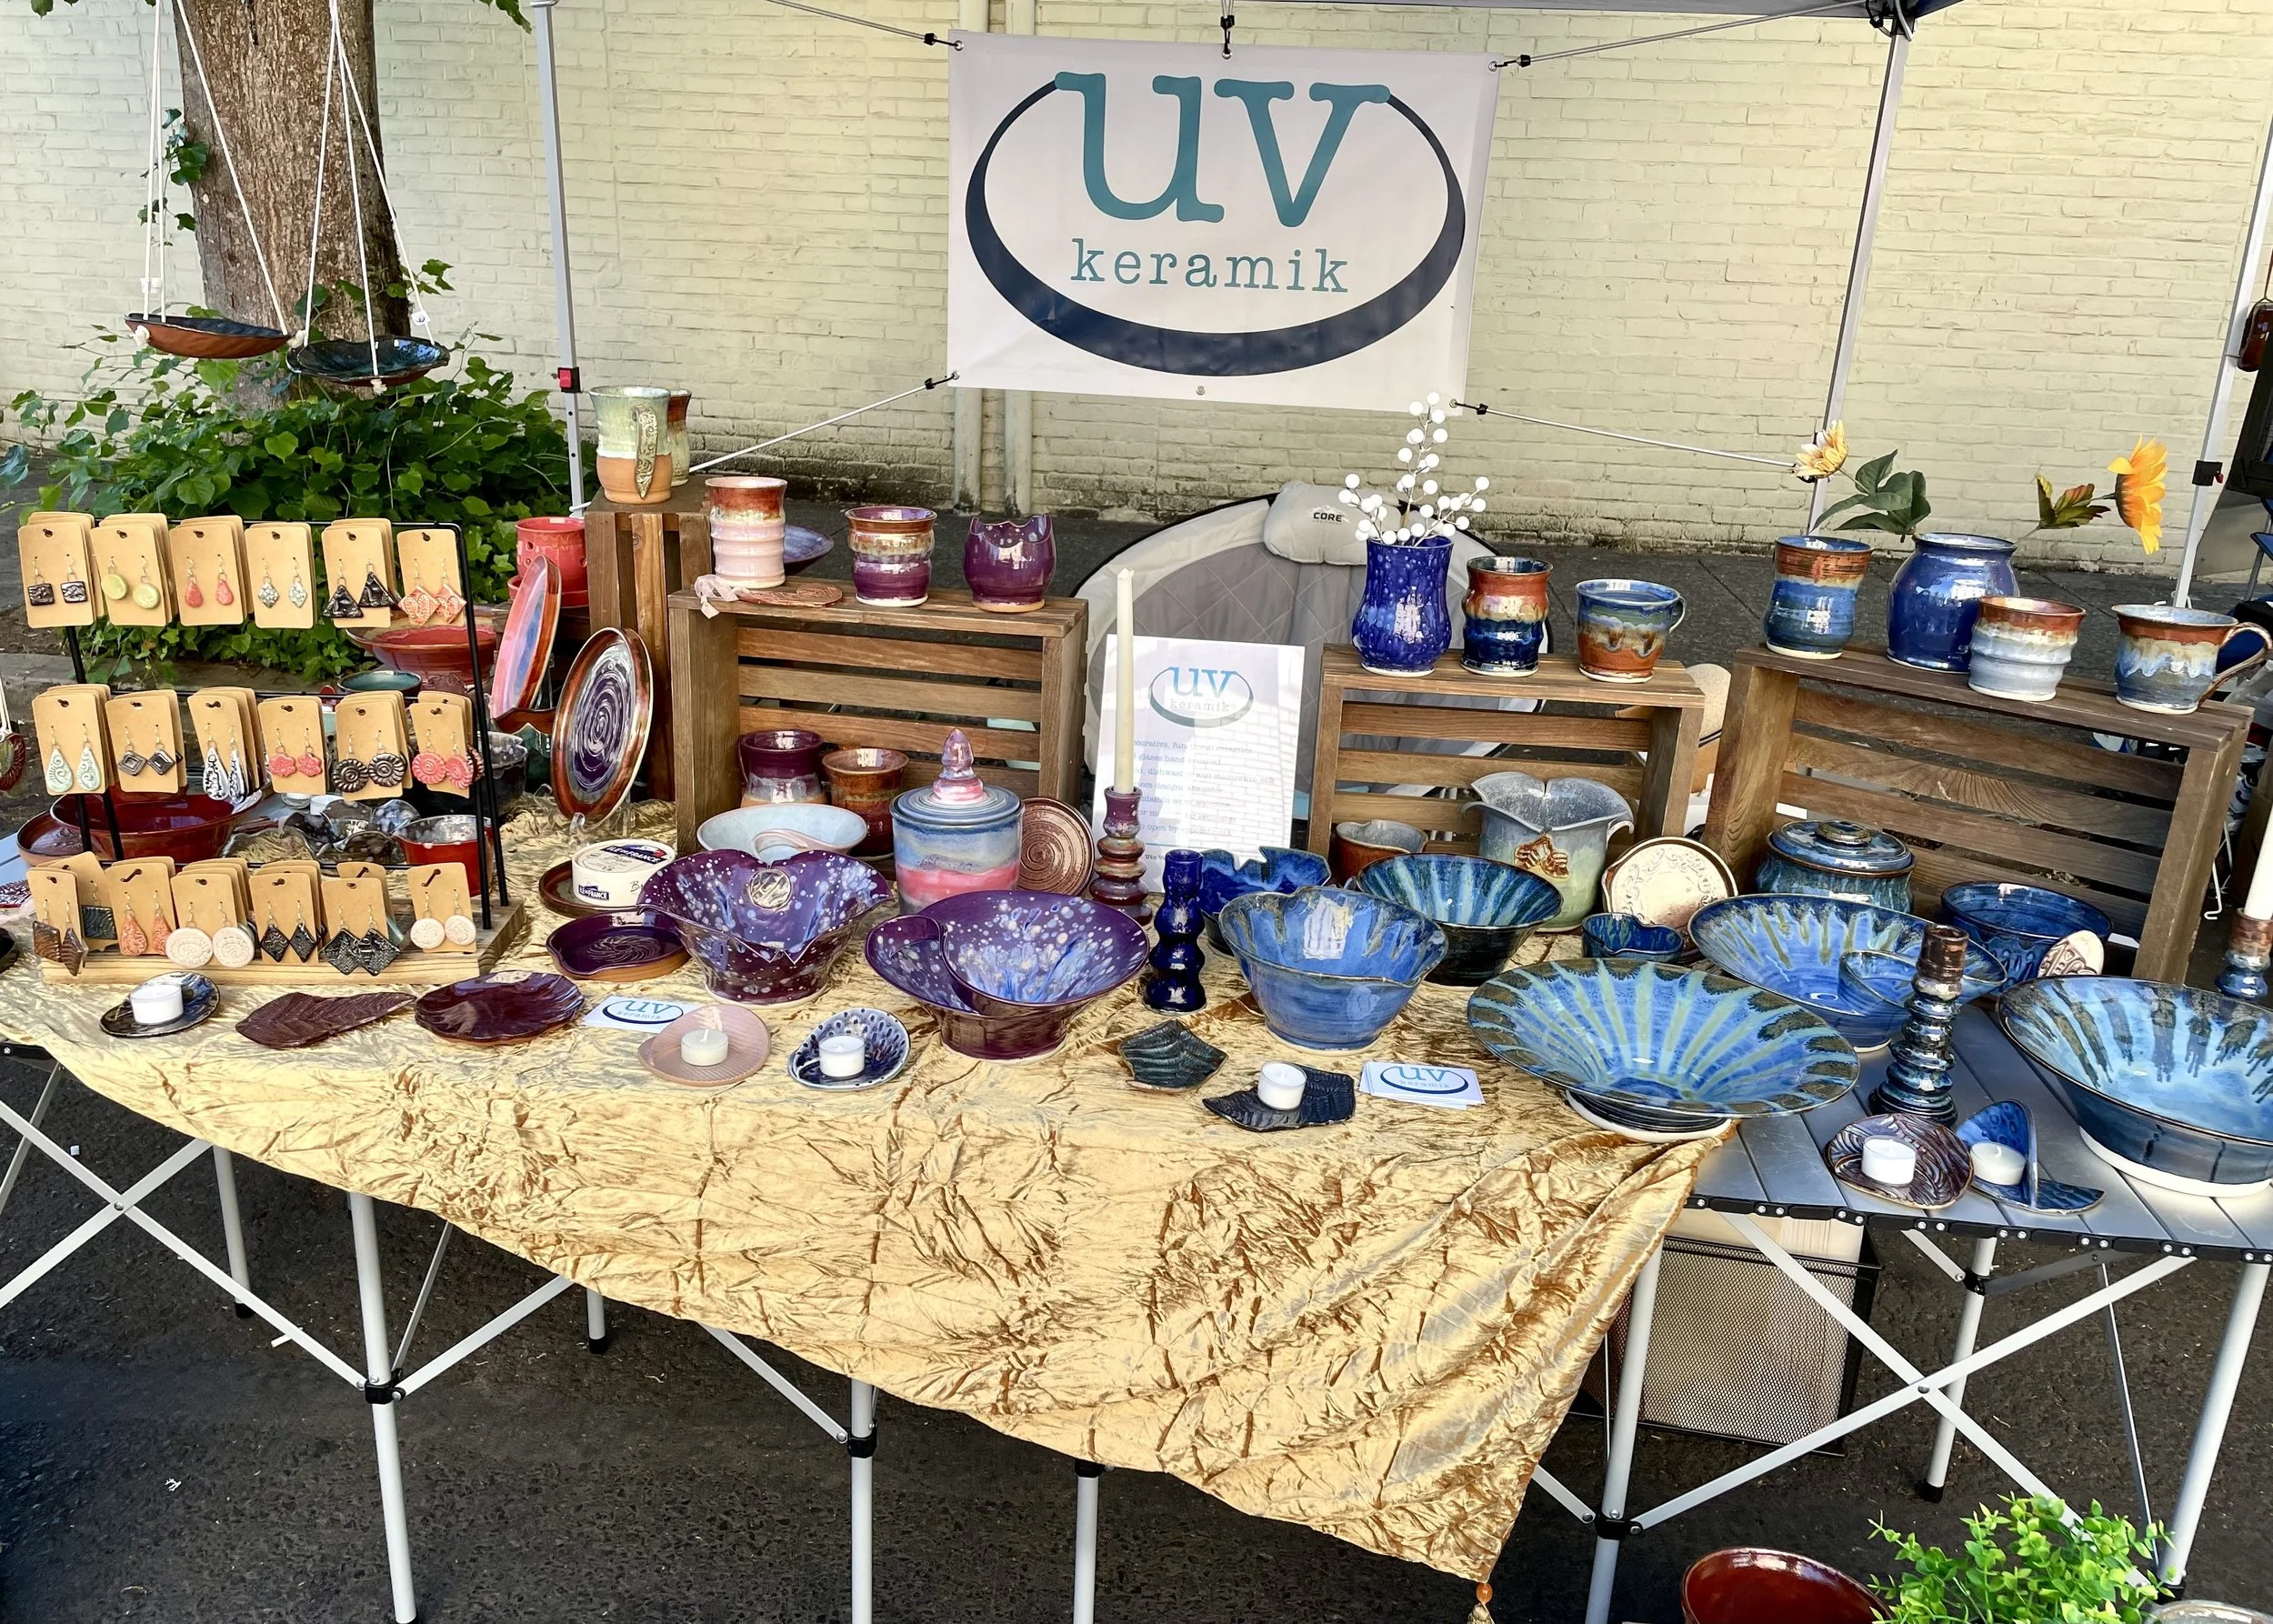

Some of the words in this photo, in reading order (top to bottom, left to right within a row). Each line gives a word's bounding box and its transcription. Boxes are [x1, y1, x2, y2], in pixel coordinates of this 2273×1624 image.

[1055, 71, 1390, 228] uv
[1069, 238, 1348, 293] keramik
[1313, 512, 1343, 523] CORE
[1169, 667, 1237, 698] uv
[1170, 698, 1230, 712] keramik
[1147, 824, 1167, 833] open
[1168, 825, 1178, 834] by
[626, 849, 661, 865] FRANCE
[588, 890, 608, 899] FRANCE
[625, 999, 674, 1015] uv
[1398, 1066, 1448, 1082] uv
